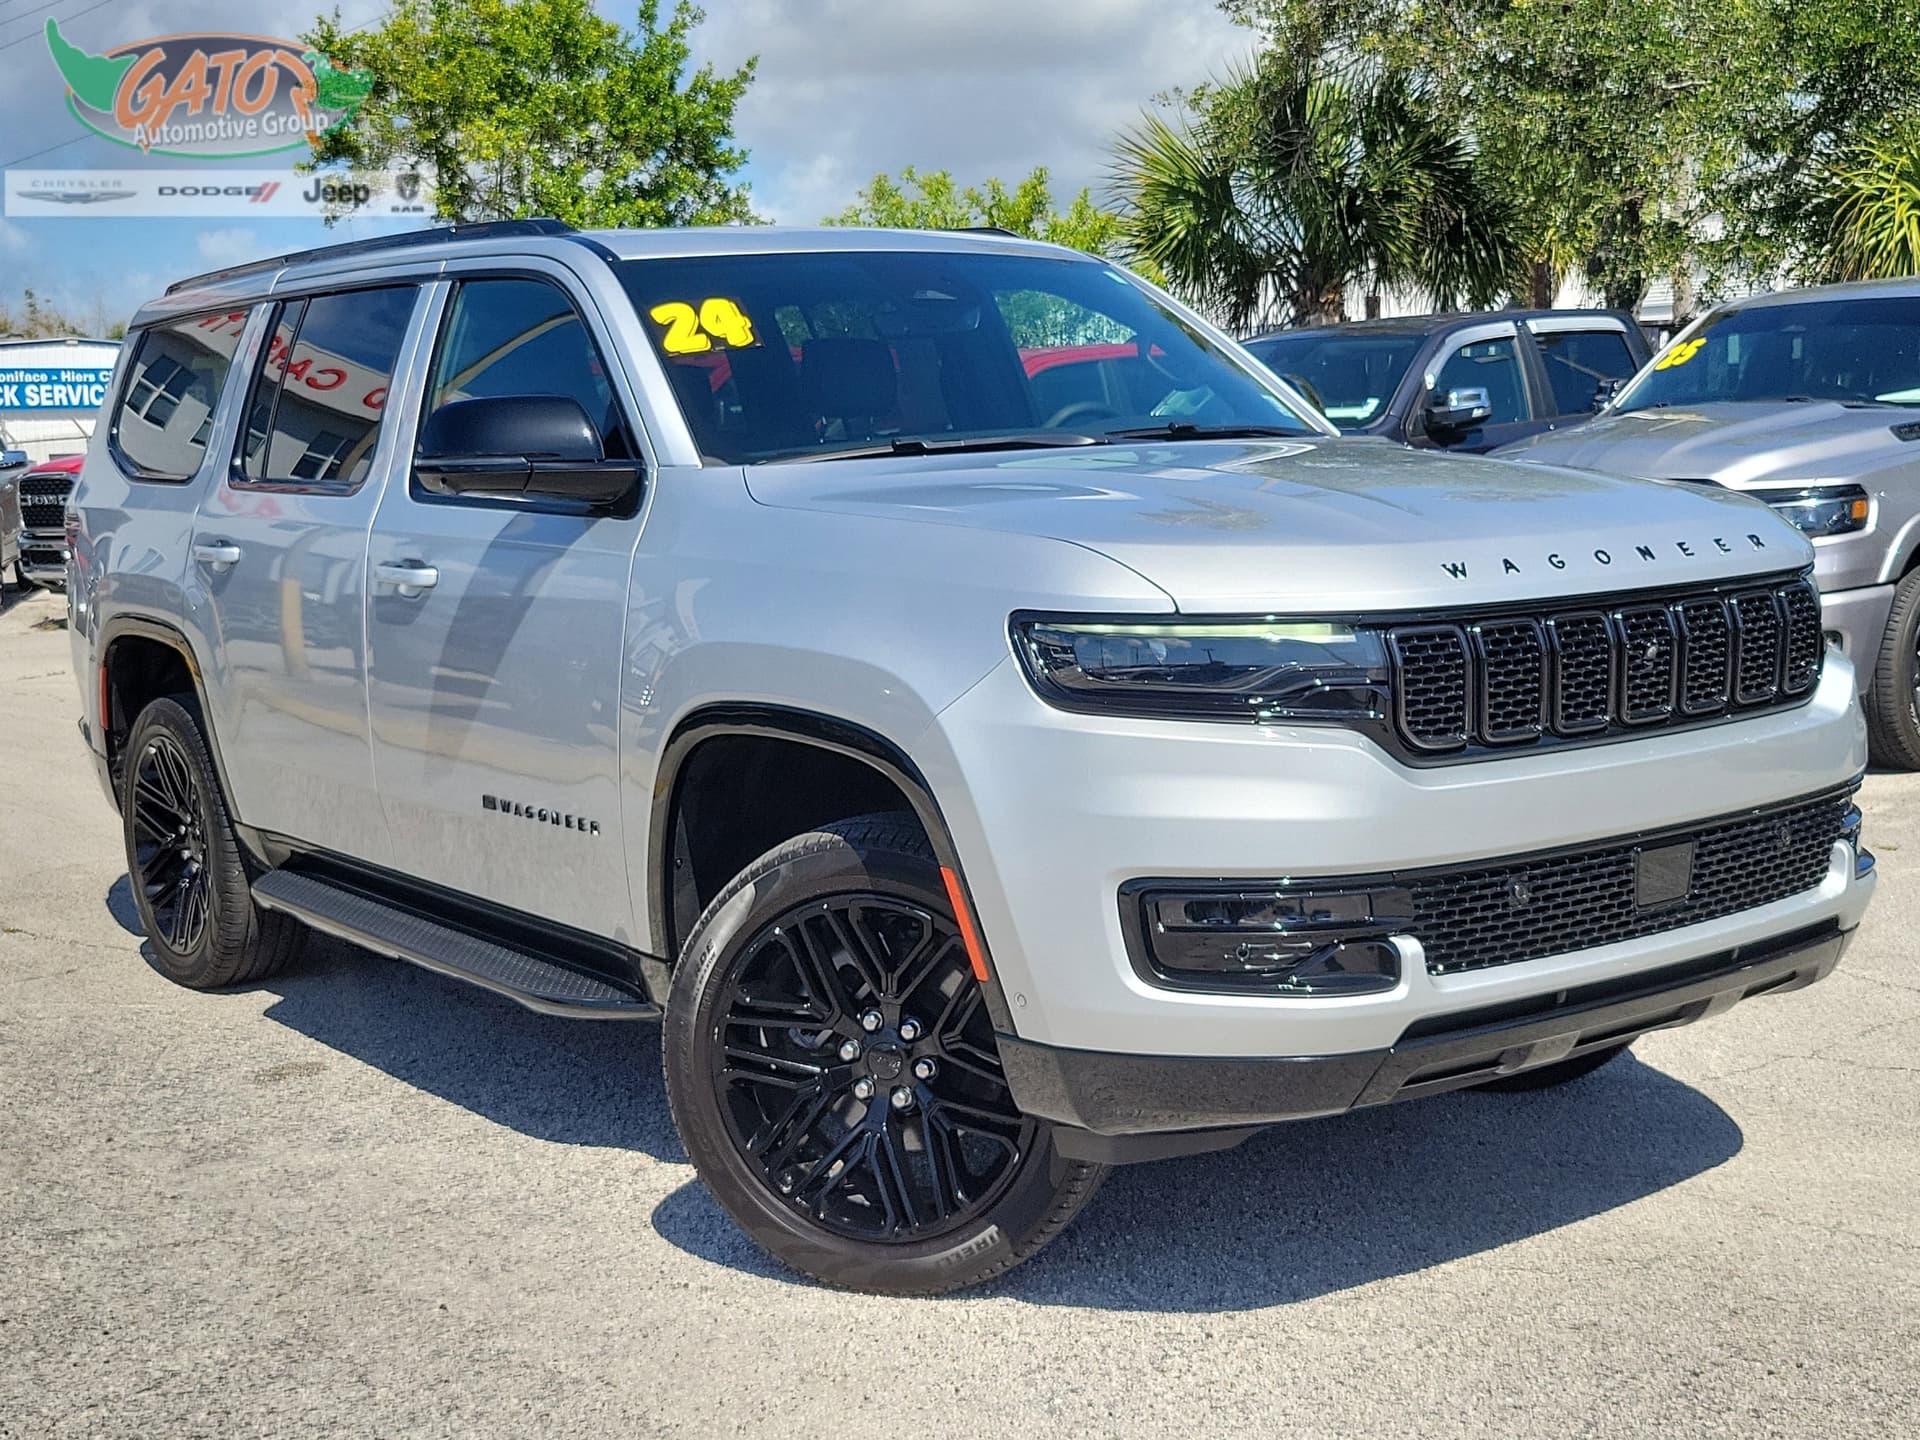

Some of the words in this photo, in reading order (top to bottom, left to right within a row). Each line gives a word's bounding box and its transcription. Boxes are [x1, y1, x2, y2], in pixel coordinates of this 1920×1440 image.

[650, 298, 754, 353] 24
[25, 384, 108, 406] SERVIC
[1441, 533, 1765, 579] WAGONEER
[500, 799, 600, 835] WAGONEER
